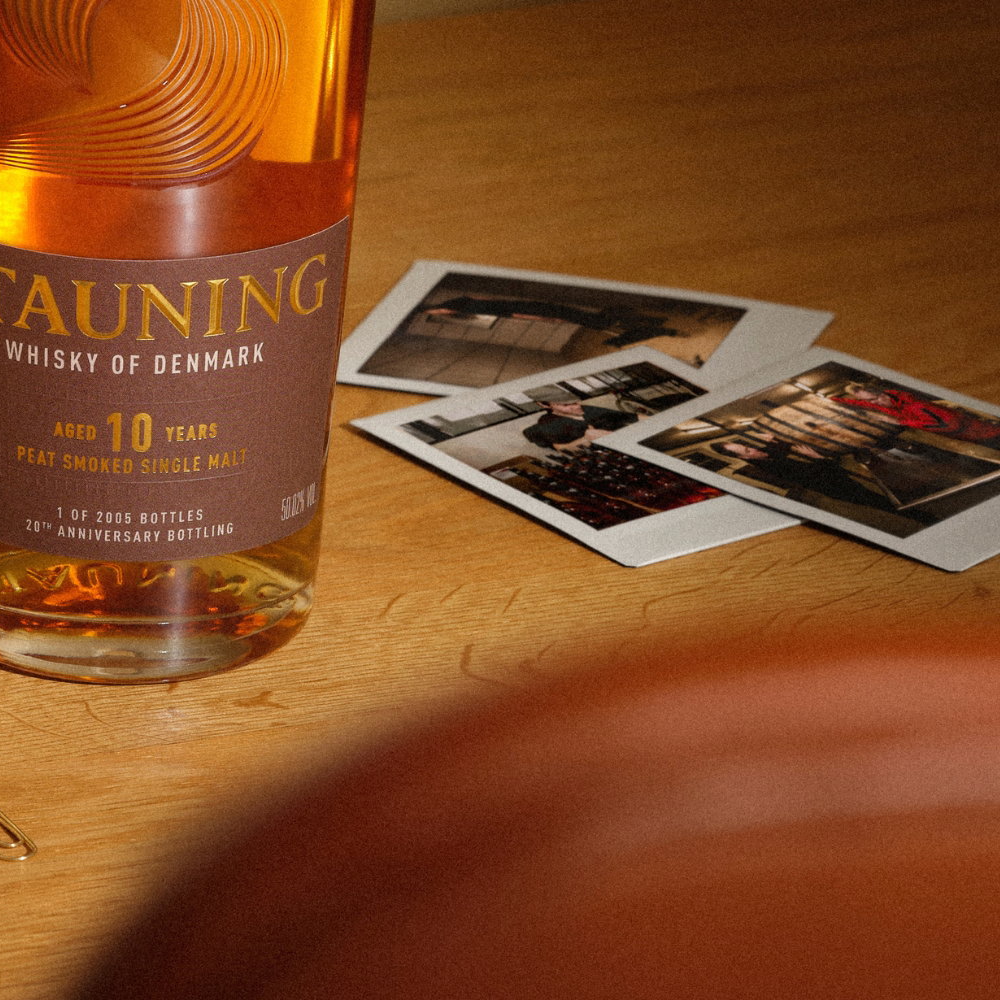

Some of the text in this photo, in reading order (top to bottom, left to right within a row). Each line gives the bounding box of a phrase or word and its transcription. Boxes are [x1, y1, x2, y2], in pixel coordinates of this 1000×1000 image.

[5, 339, 265, 376] WHISKY OF DENMARK
[53, 412, 219, 453] AGED 10 YEARS
[17, 445, 247, 474] PEAT SMOKED SINGLE MALT
[57, 506, 205, 525] 1 OF 2005 BOTTLES
[57, 524, 162, 543] ANNIVERSARY
[167, 522, 235, 542] BOTTLING
